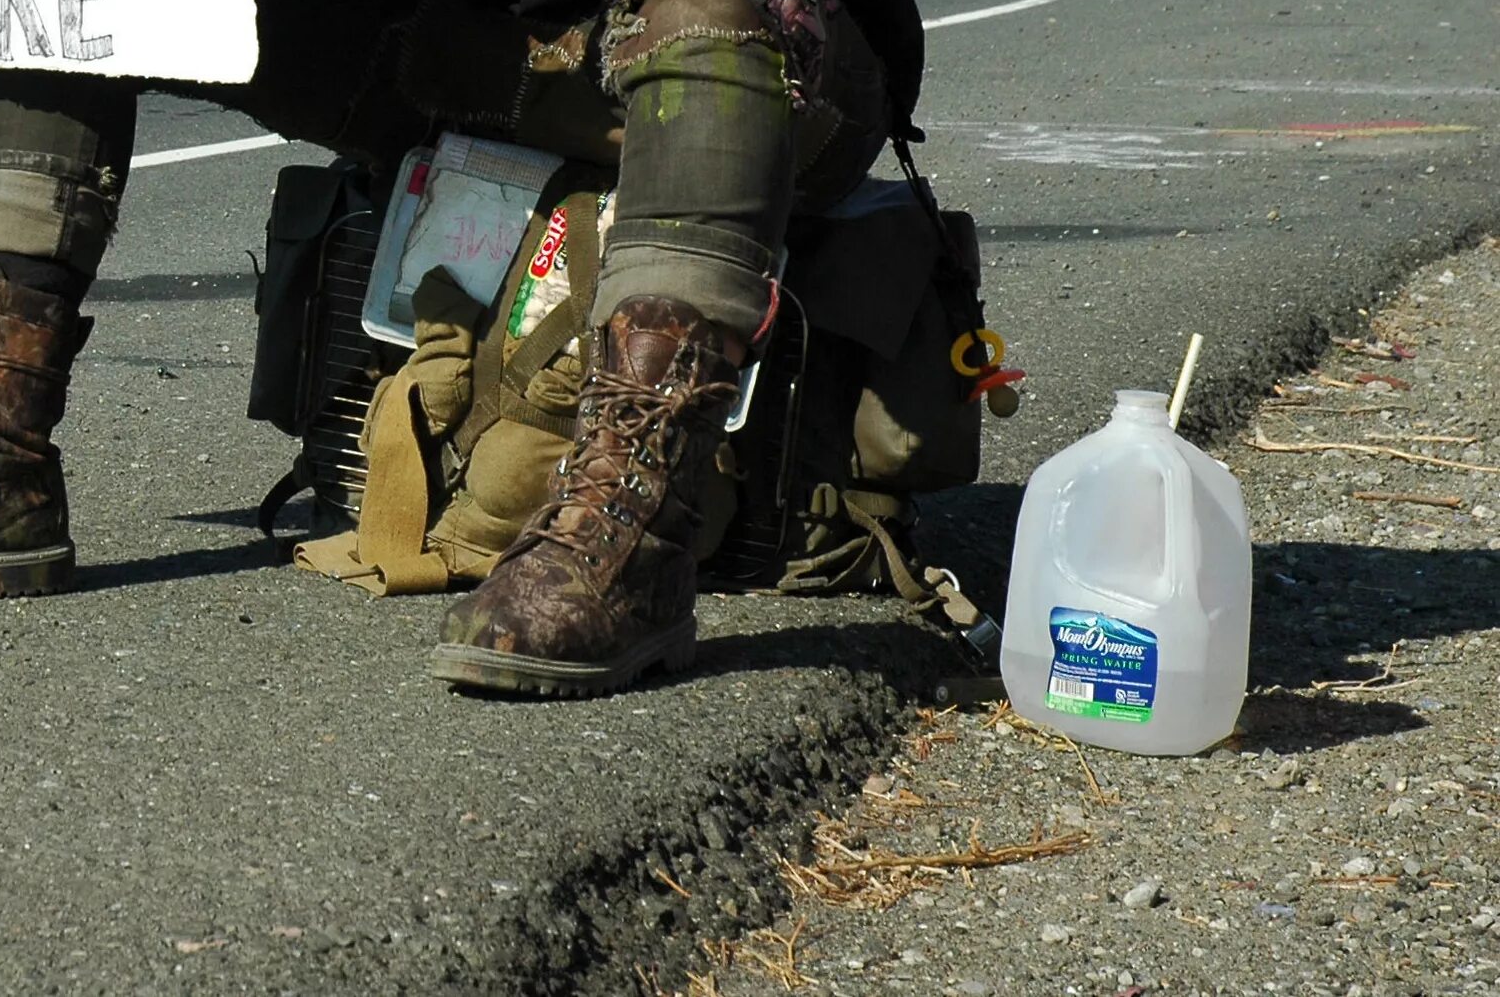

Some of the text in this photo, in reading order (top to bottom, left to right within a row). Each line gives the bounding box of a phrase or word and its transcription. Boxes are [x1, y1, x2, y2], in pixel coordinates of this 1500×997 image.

[1083, 626, 1144, 658] Olympus
[1061, 652, 1098, 665] SPRING
[1103, 657, 1142, 671] WATER
